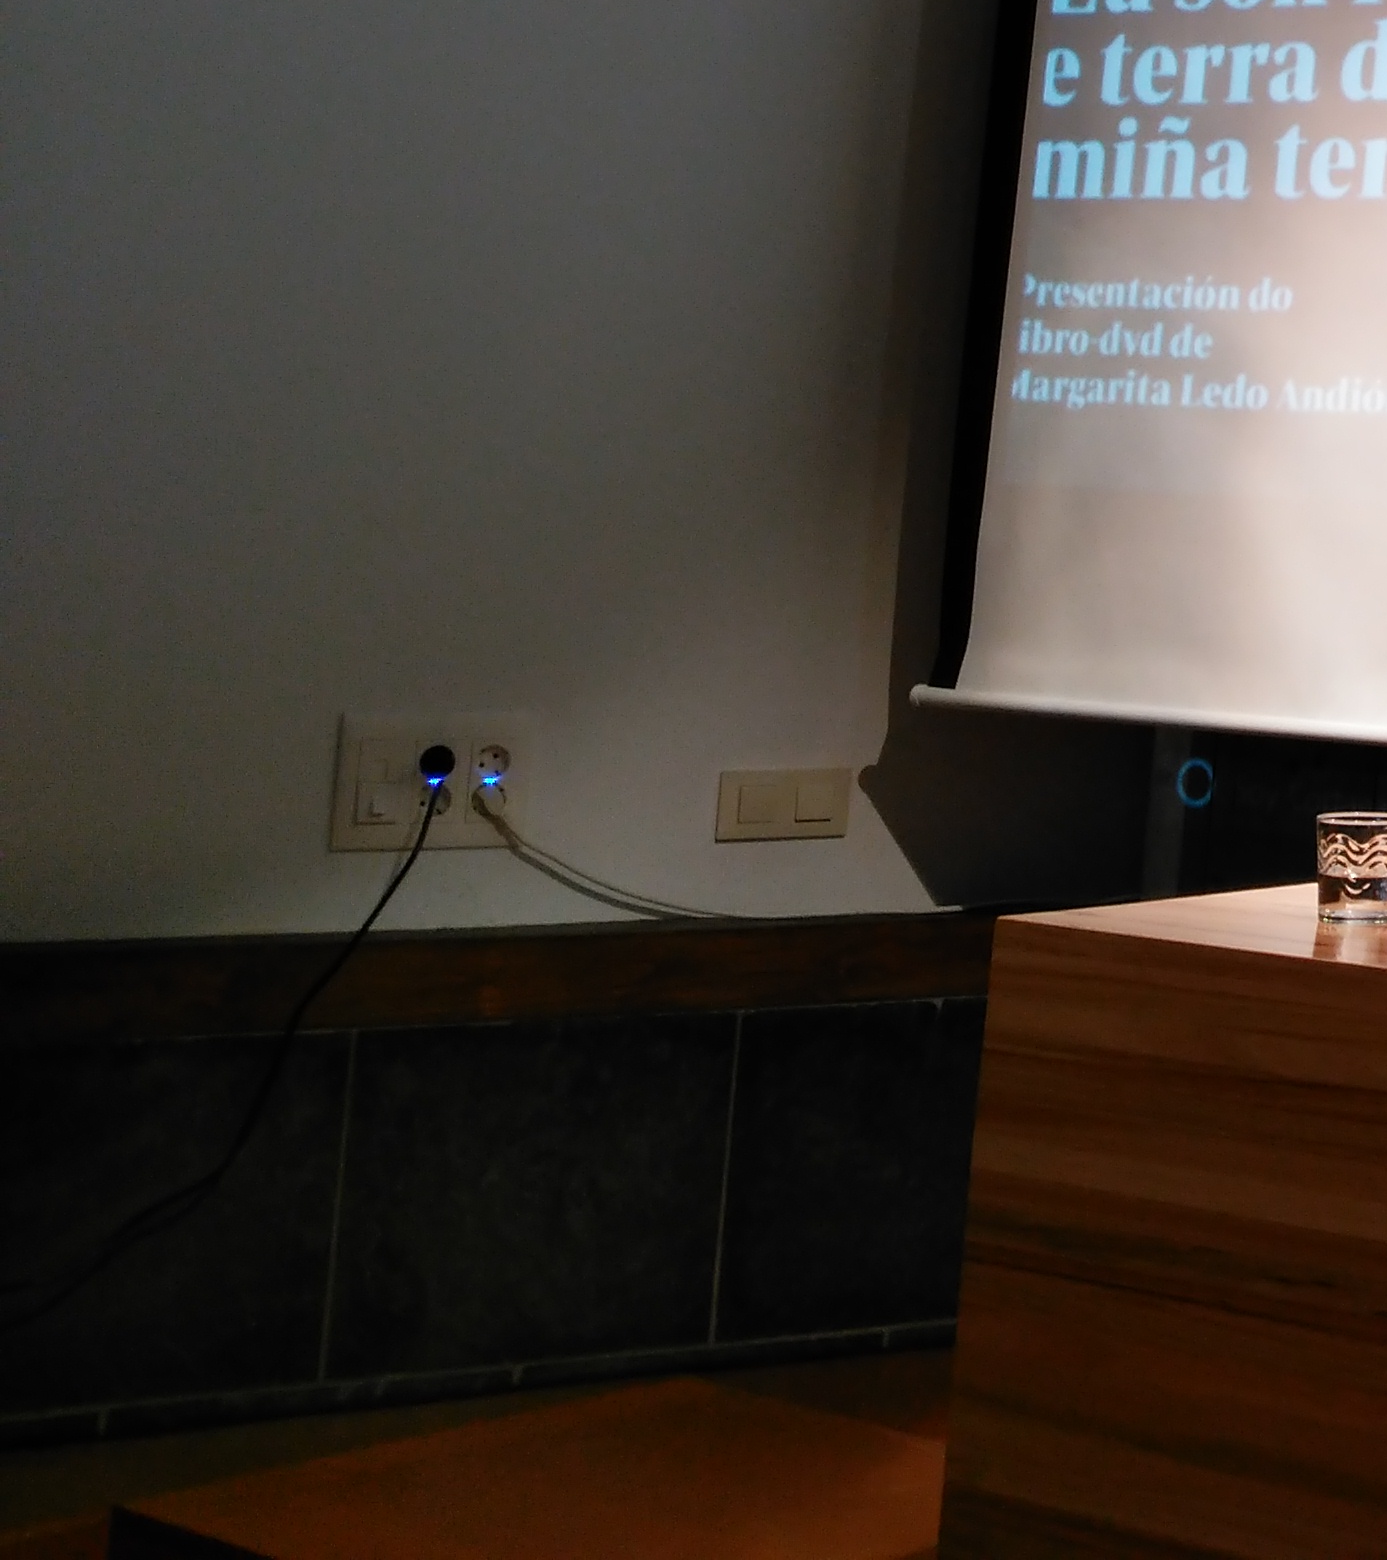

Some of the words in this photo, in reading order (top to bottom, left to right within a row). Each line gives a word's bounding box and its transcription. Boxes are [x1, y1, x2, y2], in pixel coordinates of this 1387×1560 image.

[1042, 47, 1081, 107] e
[1100, 32, 1318, 106] terra
[1032, 116, 1250, 200] miña
[1248, 276, 1294, 314] do
[1169, 321, 1214, 360] de
[1181, 373, 1270, 411] Ledo
